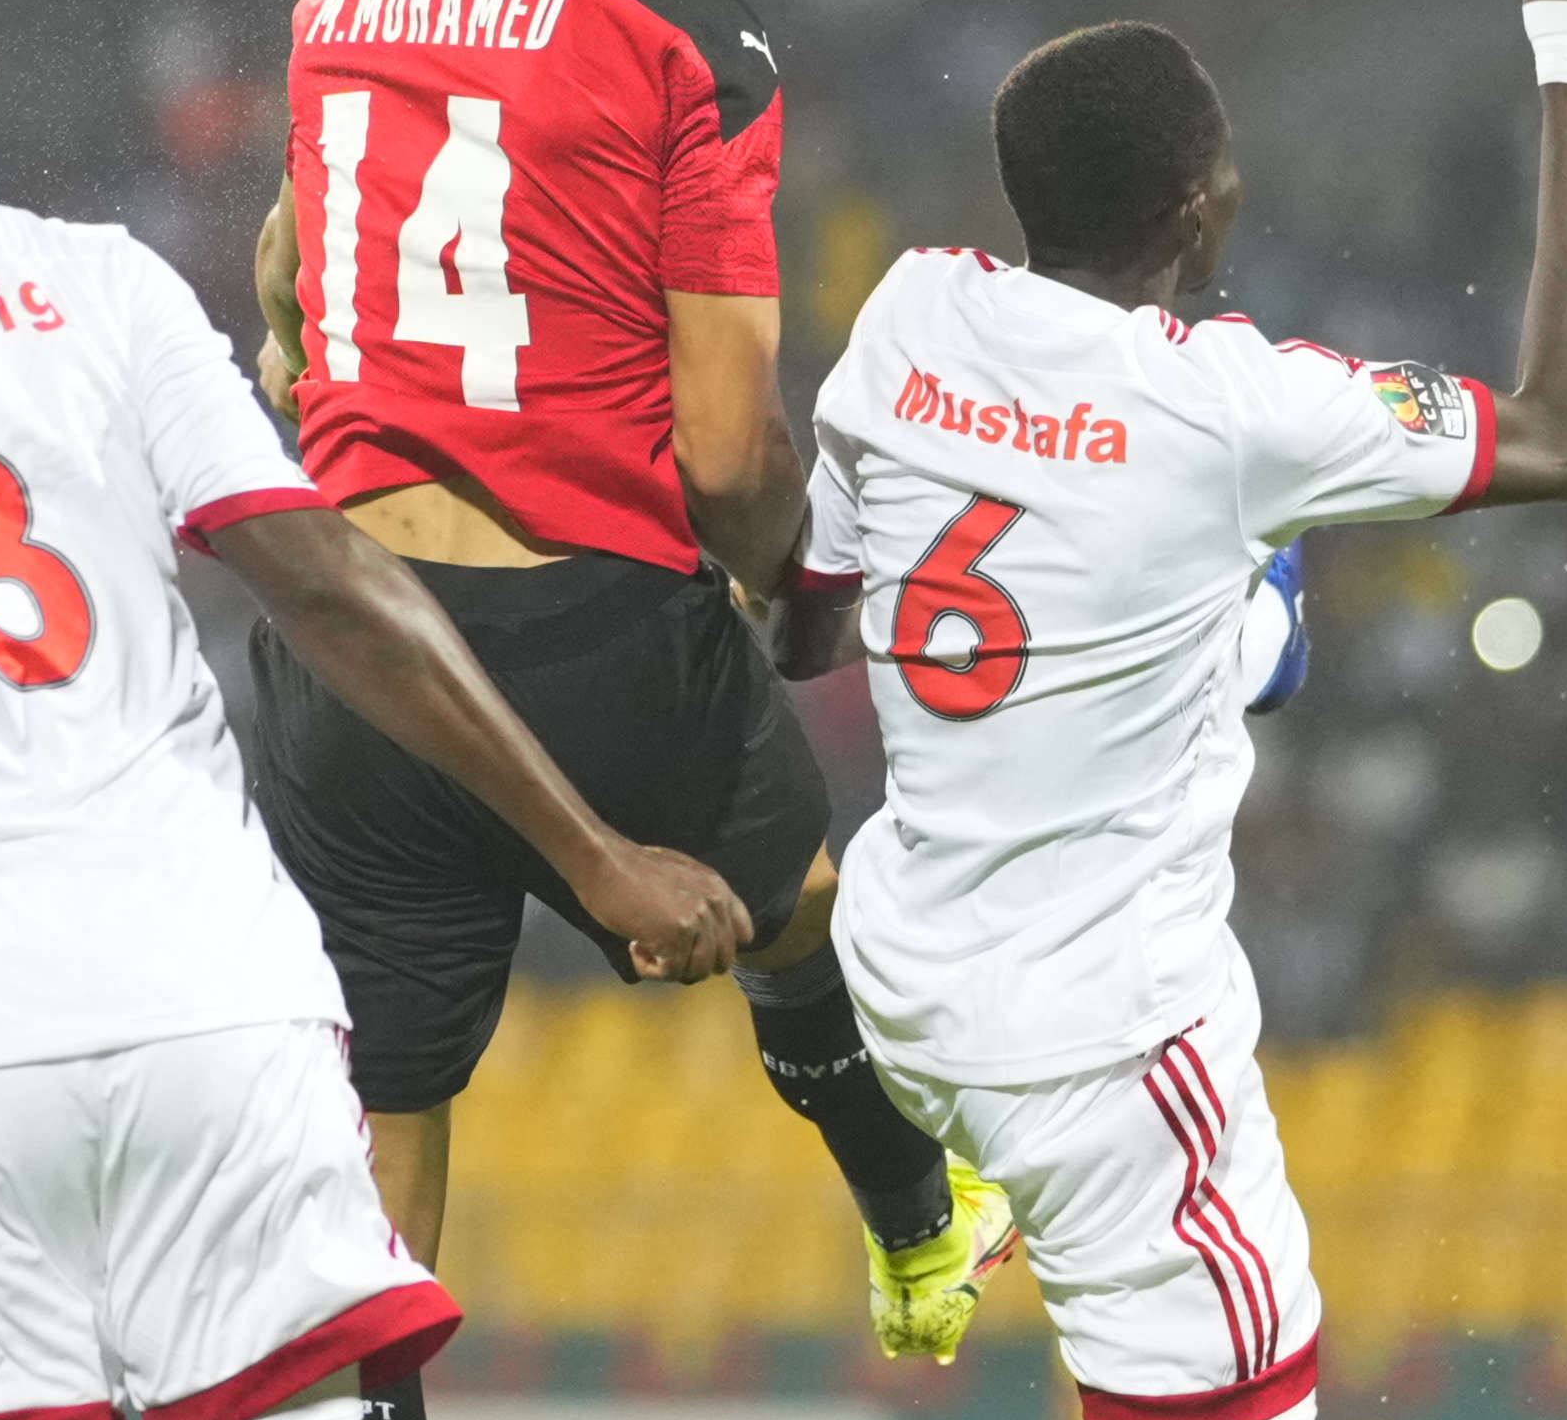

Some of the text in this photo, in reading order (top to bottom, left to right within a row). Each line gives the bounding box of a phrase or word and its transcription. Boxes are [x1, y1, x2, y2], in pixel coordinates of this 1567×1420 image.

[317, 90, 531, 412] 14
[893, 367, 1129, 464] Mustafa
[886, 492, 1032, 723] 6
